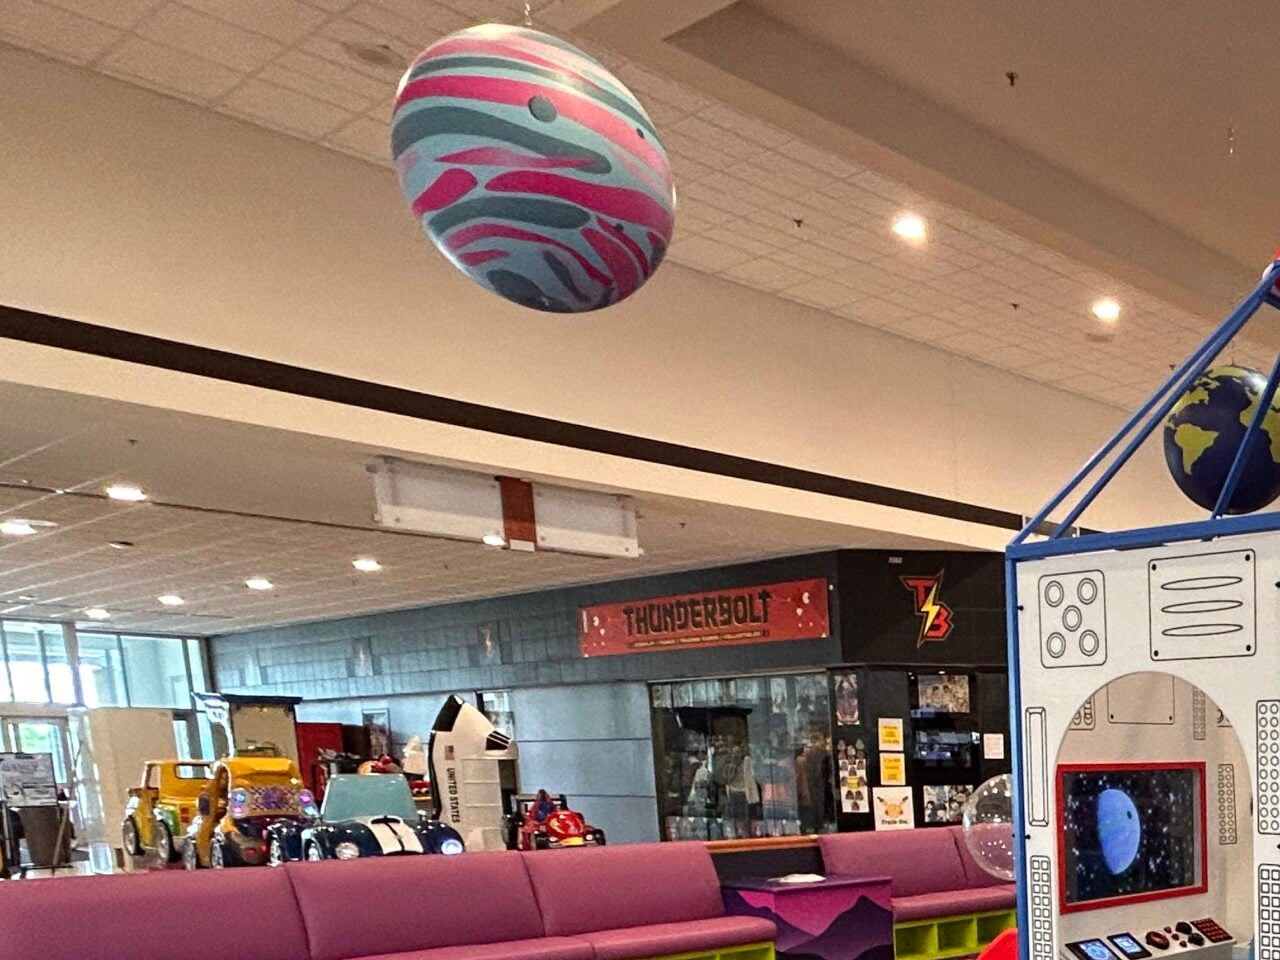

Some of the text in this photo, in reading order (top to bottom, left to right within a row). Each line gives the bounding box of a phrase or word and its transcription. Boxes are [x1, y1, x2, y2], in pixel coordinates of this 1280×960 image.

[623, 590, 772, 636] THUNDERBOLT
[447, 768, 460, 823] UNITED STATES
